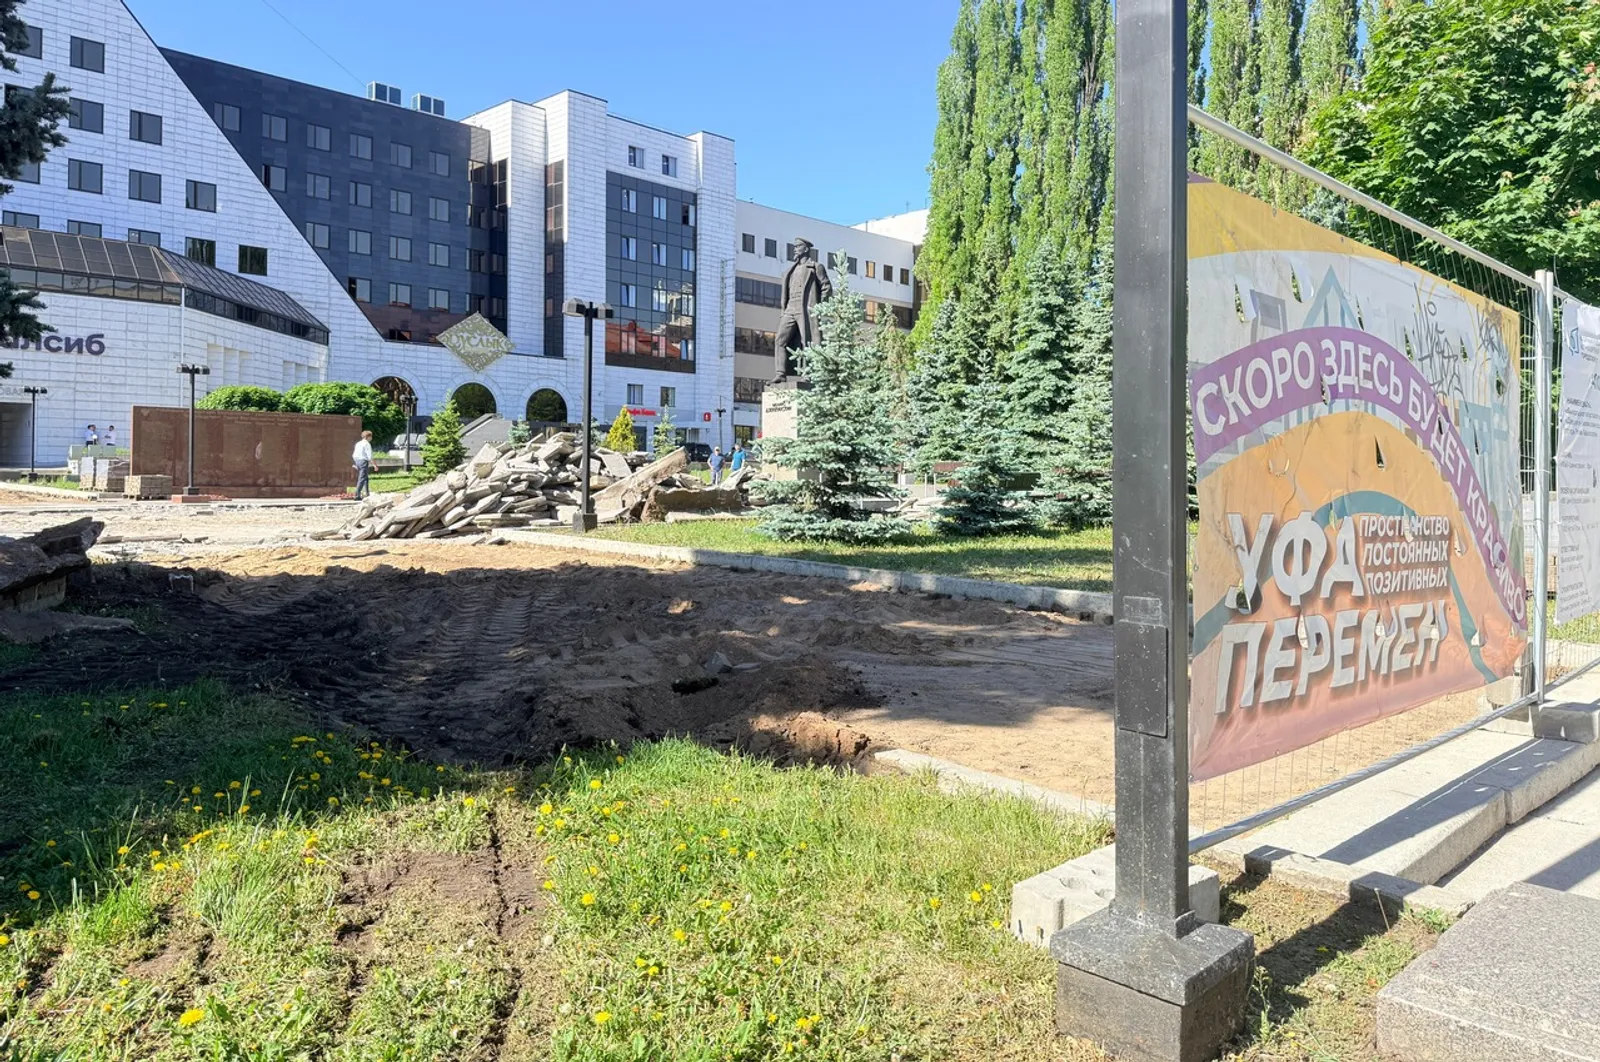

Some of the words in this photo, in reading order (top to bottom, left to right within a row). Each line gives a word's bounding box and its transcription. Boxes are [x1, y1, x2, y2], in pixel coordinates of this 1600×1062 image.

[1196, 341, 1315, 436] СКОРО
[1320, 339, 1403, 405] ЗДЕСЬ
[1408, 378, 1466, 486] БУДЕТ
[1467, 476, 1524, 620] КРАИВО
[1224, 511, 1364, 606] УФА
[1362, 540, 1449, 567] ПОСТОЯННЫХ
[1365, 566, 1448, 595] ПОЗИТИВНЫХ
[1214, 600, 1448, 715] ПЕРЕМЕН
